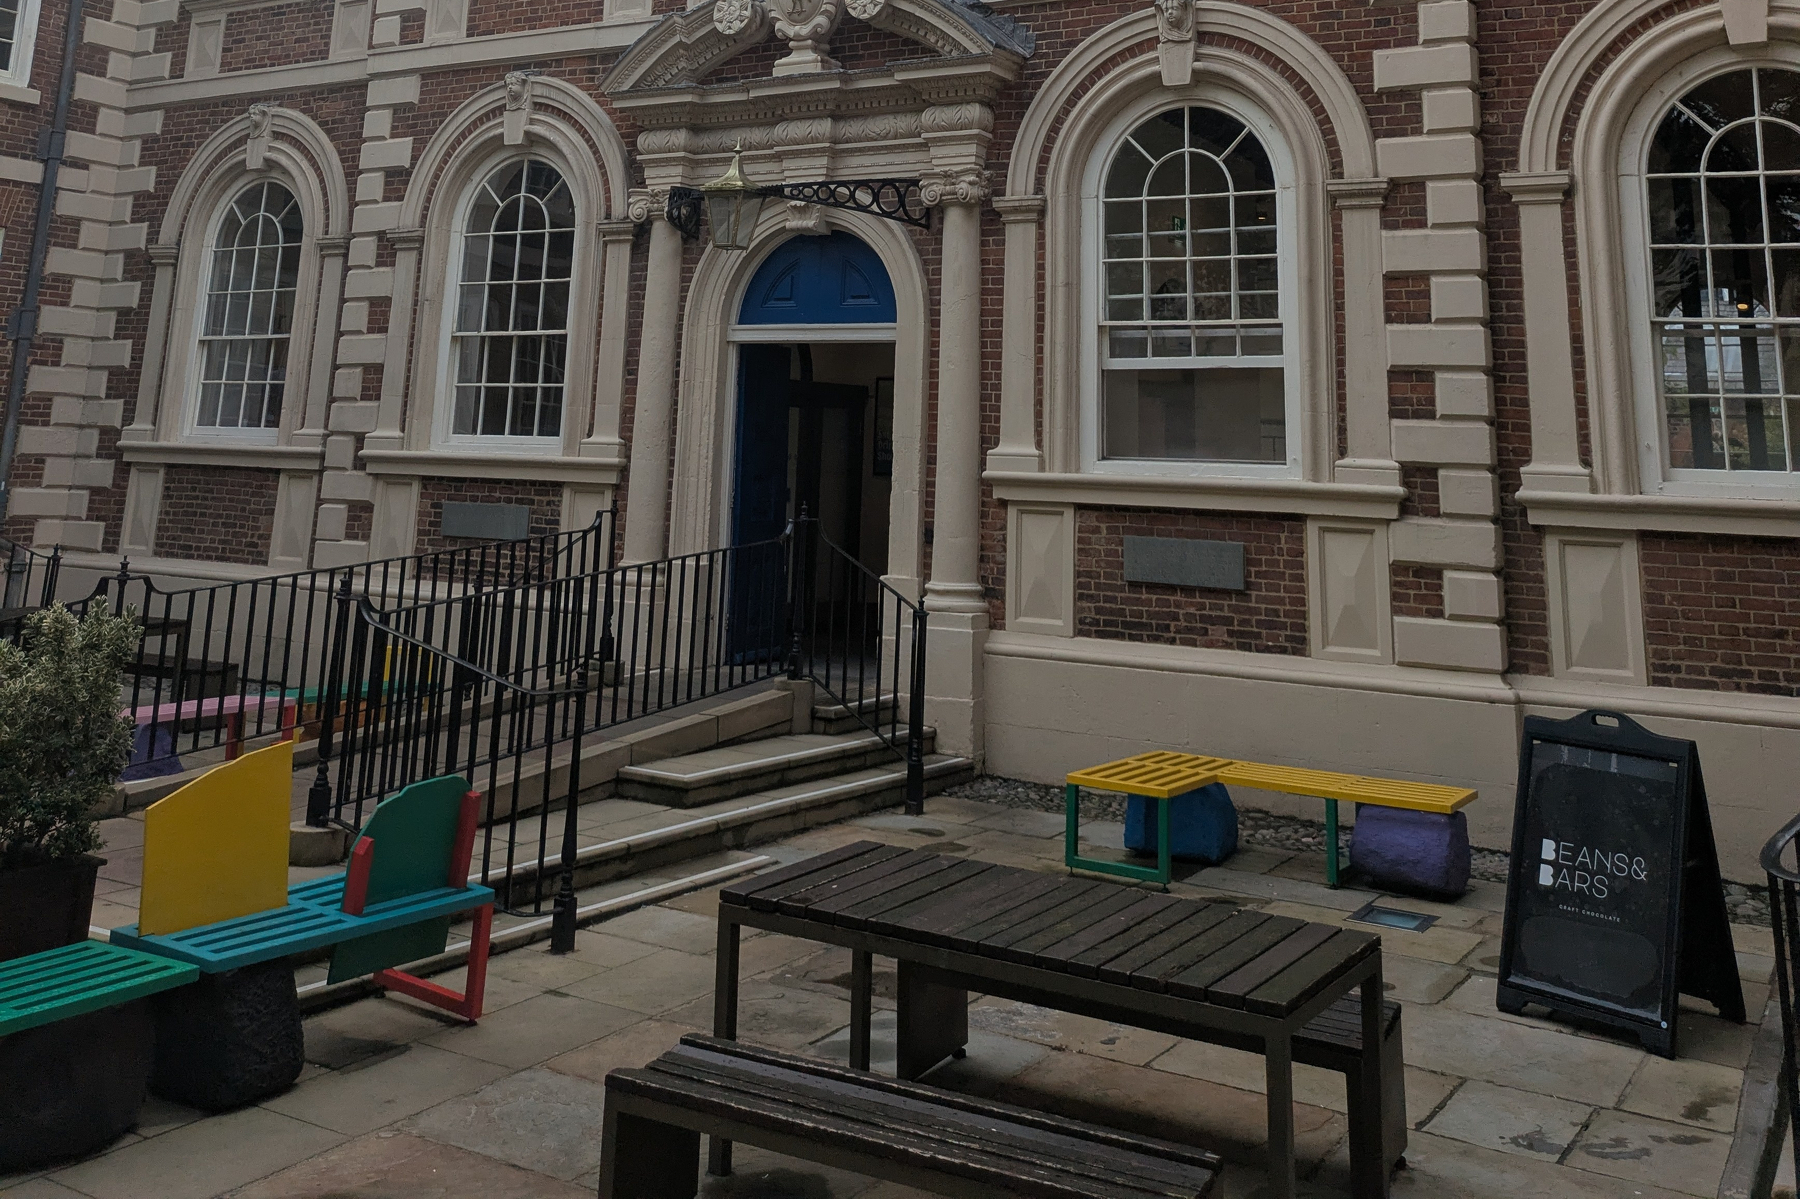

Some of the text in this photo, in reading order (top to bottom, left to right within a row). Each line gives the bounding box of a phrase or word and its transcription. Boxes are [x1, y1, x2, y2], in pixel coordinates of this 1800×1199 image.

[1541, 838, 1648, 881] BEANS&
[1539, 863, 1608, 899] BARS
[1558, 904, 1621, 923] CRAFT CHOCOLATE
